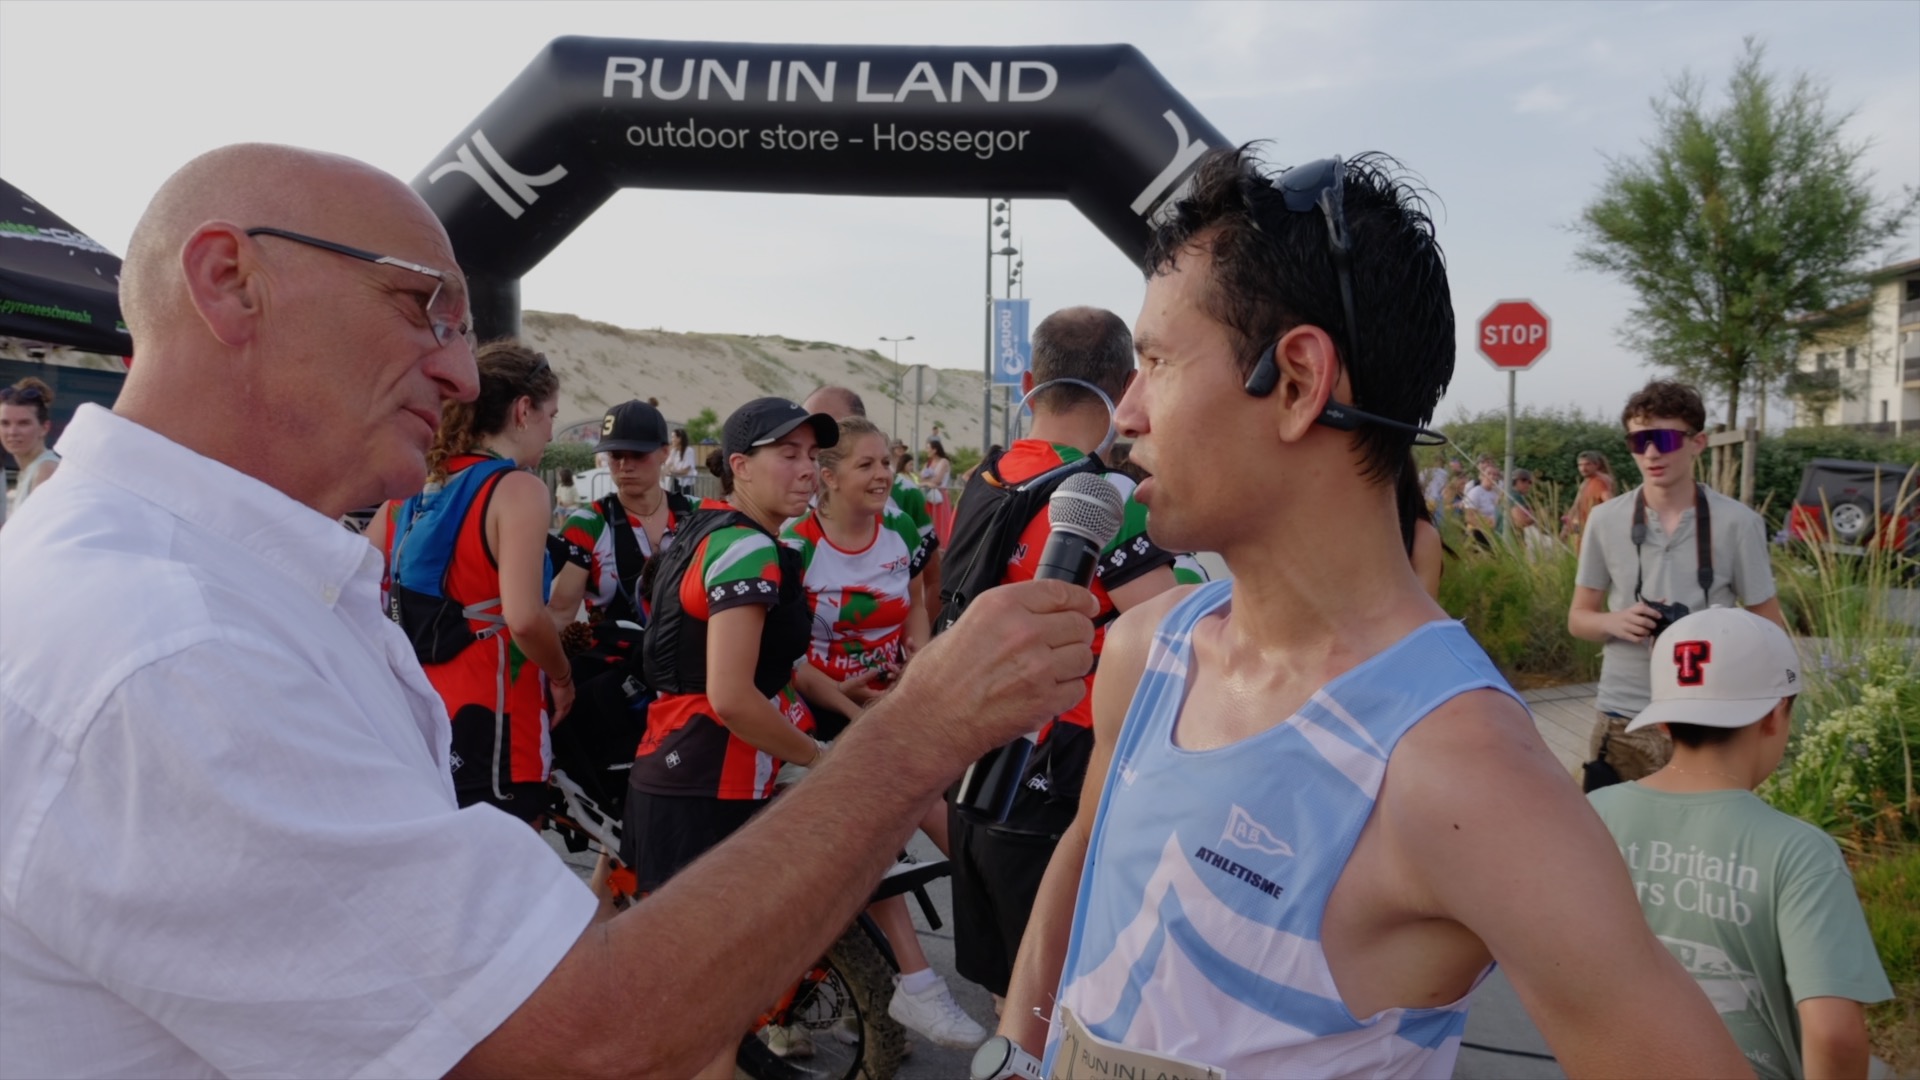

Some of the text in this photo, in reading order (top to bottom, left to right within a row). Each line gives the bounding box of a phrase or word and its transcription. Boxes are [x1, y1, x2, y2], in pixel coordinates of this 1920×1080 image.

[602, 56, 1058, 103] RUN IN LAND
[627, 118, 749, 148] outdoor
[760, 124, 839, 150] store
[874, 123, 1030, 159] Hossegor
[1484, 325, 1543, 345] STOP
[602, 414, 616, 436] 3
[1673, 639, 1711, 686] T
[1195, 846, 1285, 900] ATHLETISME
[1647, 840, 1759, 894] Britain
[1673, 877, 1753, 928] Club
[1081, 1049, 1109, 1075] RUN
[1113, 1063, 1136, 1080] IN
